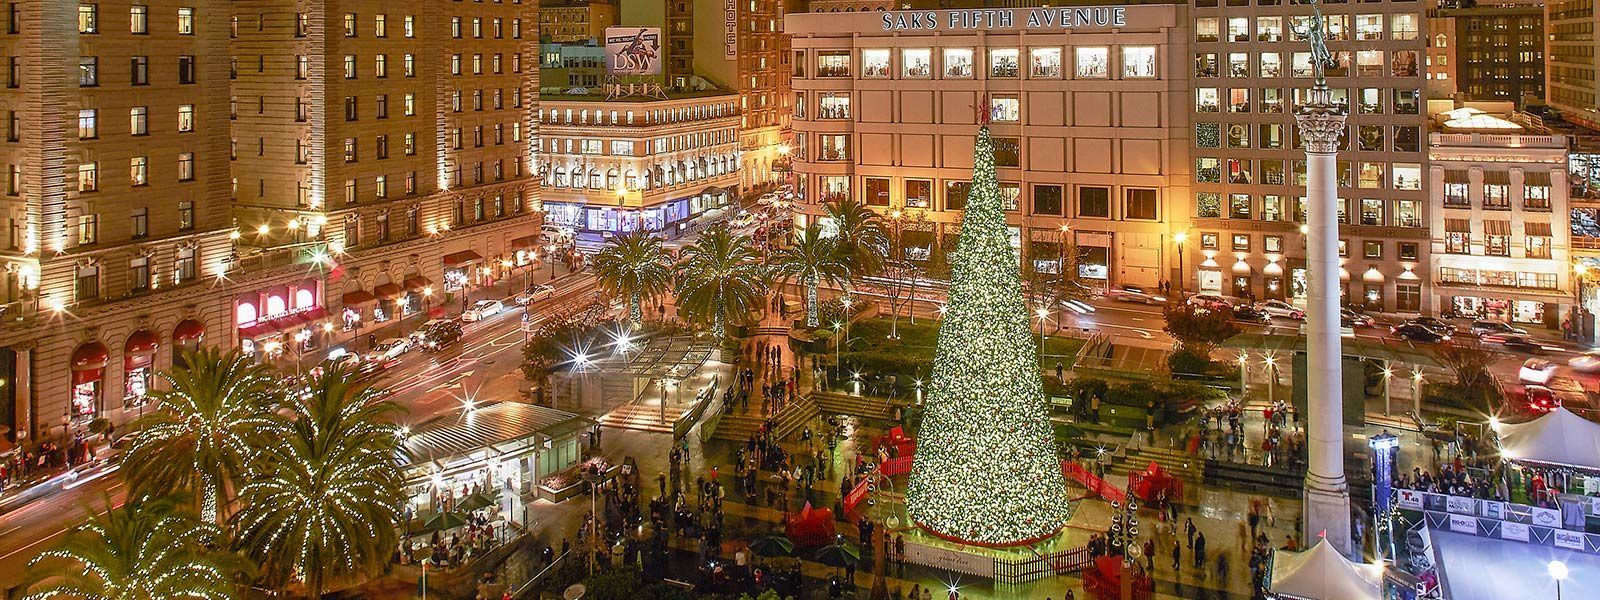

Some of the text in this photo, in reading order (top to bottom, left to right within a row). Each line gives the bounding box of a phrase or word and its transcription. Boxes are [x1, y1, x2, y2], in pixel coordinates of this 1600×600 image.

[725, 0, 737, 56] HOTEL
[882, 7, 1127, 31] SAKS FIFTH AVENUE
[613, 53, 653, 70] DSW
